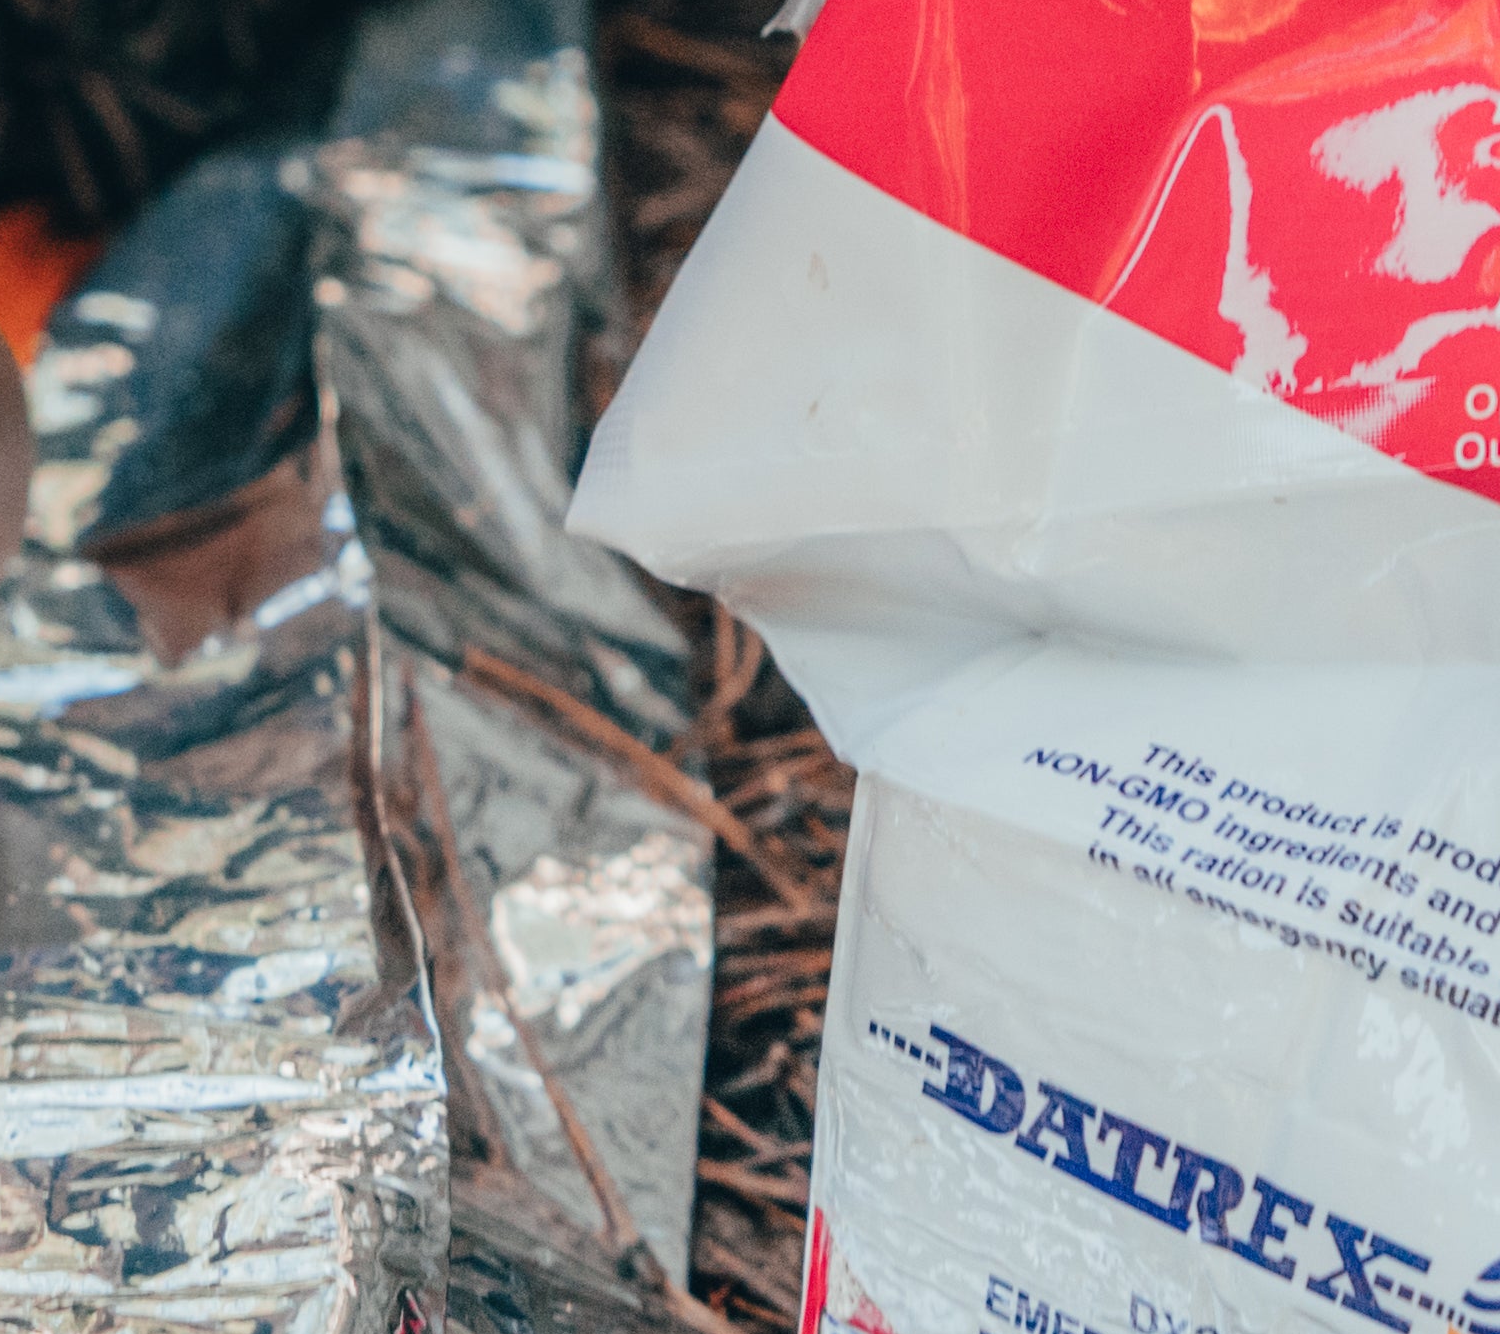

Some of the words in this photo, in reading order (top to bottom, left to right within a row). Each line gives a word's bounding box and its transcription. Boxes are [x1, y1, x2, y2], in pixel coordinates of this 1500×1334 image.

[1023, 747, 1210, 823] NON-GMO
[1214, 814, 1419, 898] ingredients
[1144, 742, 1217, 786] This
[1219, 778, 1367, 835] product
[1371, 814, 1402, 839] is
[1088, 839, 1120, 872] in
[1133, 863, 1175, 893] all
[1186, 886, 1387, 981] emergency
[1100, 804, 1174, 853] This
[1180, 846, 1287, 897] ration
[1296, 876, 1329, 910] is
[1339, 899, 1490, 976] suitable
